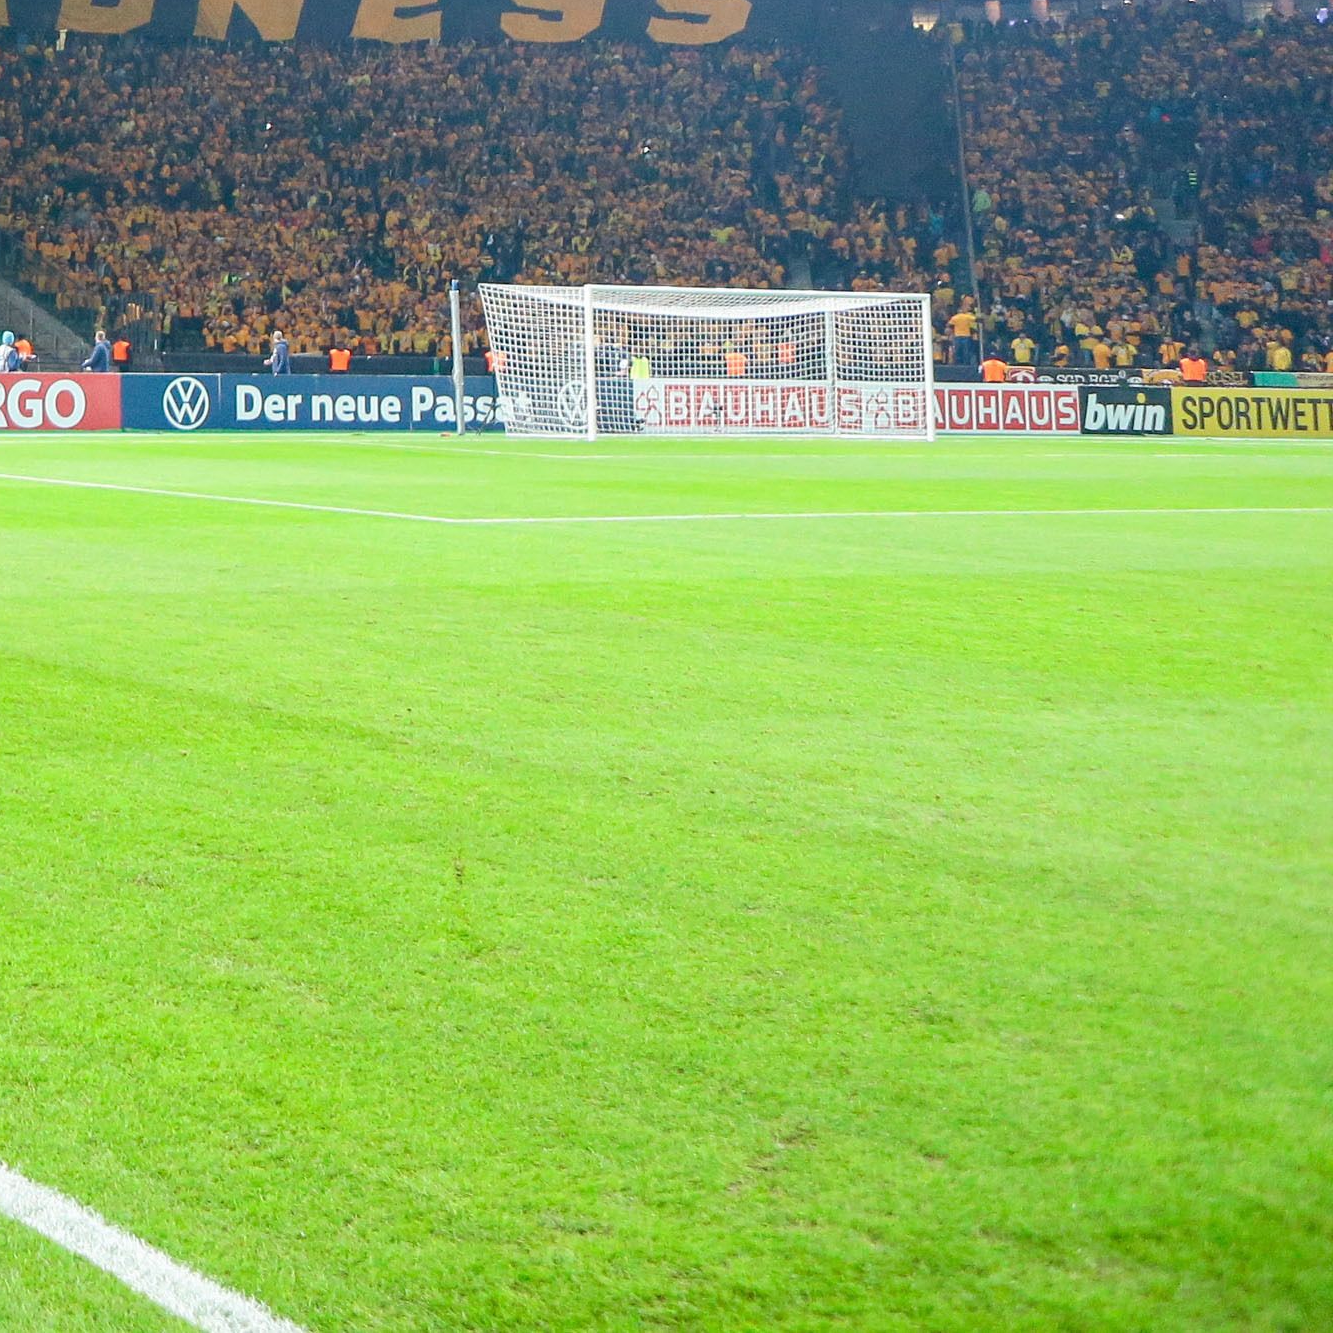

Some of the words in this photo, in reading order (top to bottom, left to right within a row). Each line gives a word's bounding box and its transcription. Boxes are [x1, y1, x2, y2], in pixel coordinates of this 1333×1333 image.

[235, 384, 302, 422] Der
[310, 394, 402, 422] neue
[665, 385, 864, 429] BAUHAUS
[1084, 392, 1167, 432] bwin
